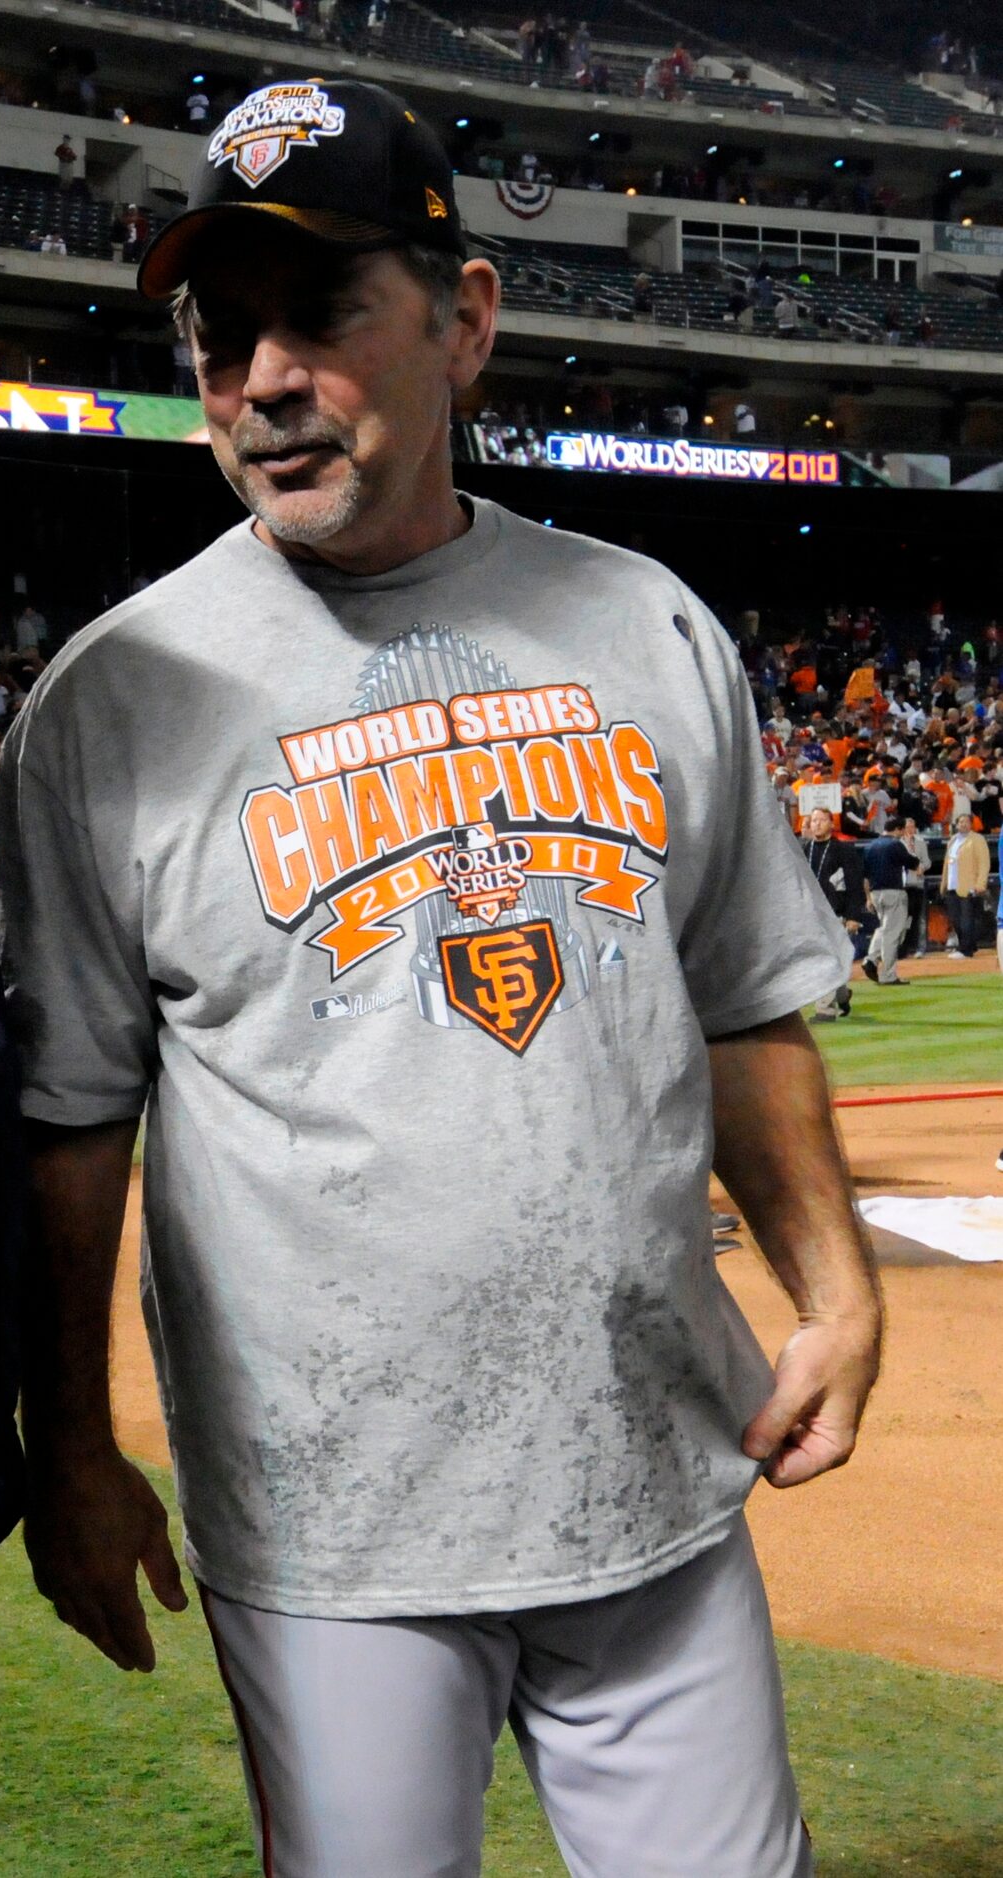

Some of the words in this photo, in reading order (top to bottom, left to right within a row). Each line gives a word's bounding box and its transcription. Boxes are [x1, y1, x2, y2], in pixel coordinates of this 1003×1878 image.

[268, 87, 313, 97] 2010
[769, 453, 839, 483] 2010
[283, 703, 449, 783] WORLD
[452, 686, 599, 741] SERIES
[242, 722, 668, 926] CHAMPIONS
[424, 838, 533, 880] WORLD
[445, 864, 526, 900] SERIES
[466, 929, 538, 1030] SF
